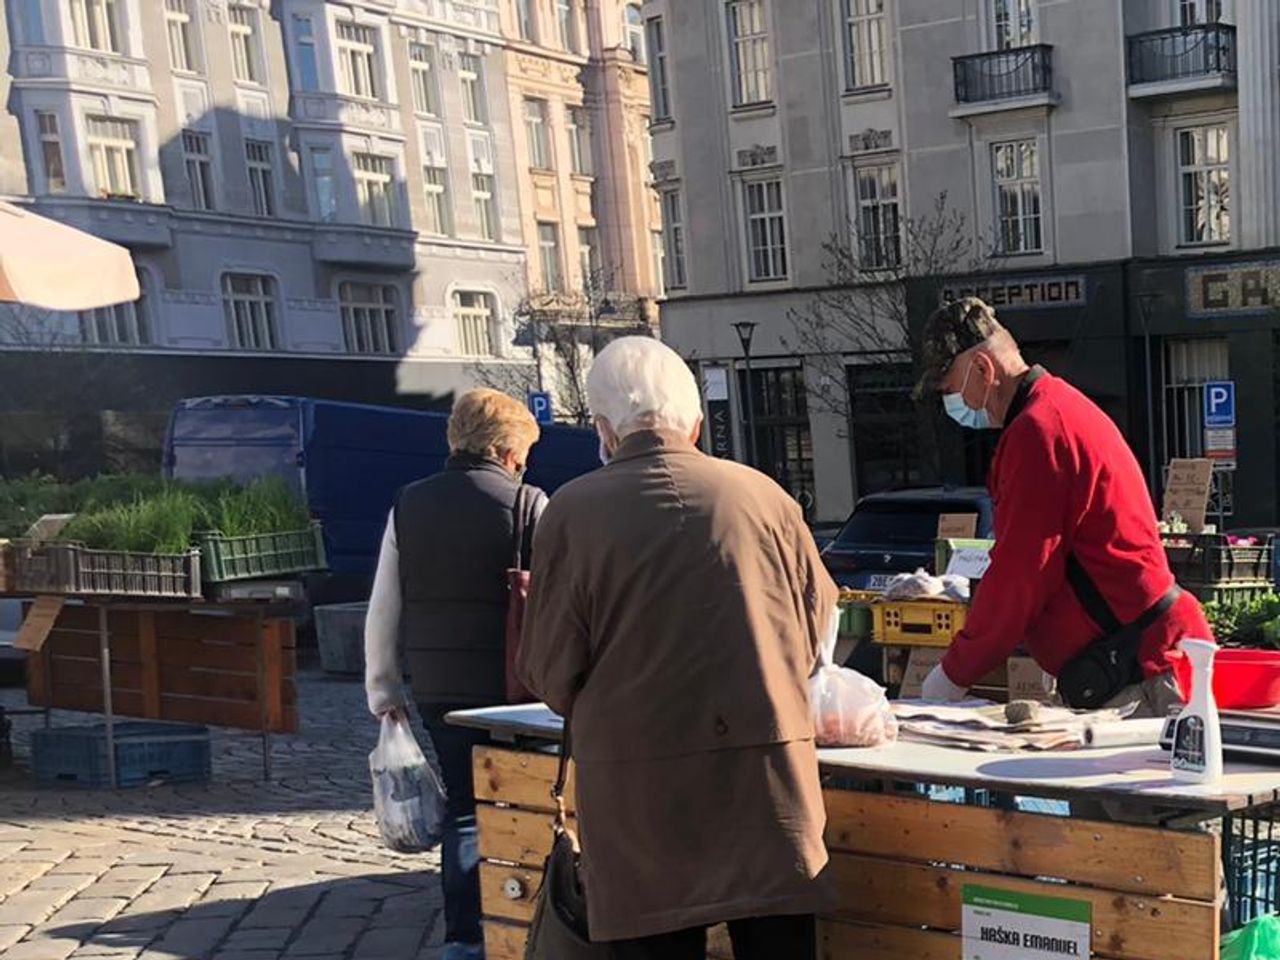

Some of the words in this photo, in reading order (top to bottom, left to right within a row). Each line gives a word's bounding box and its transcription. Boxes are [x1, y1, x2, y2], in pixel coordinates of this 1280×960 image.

[534, 396, 547, 419] P
[1211, 387, 1228, 413] P
[980, 926, 1020, 947] HAŠKA
[1023, 933, 1077, 955] EMANUEL
